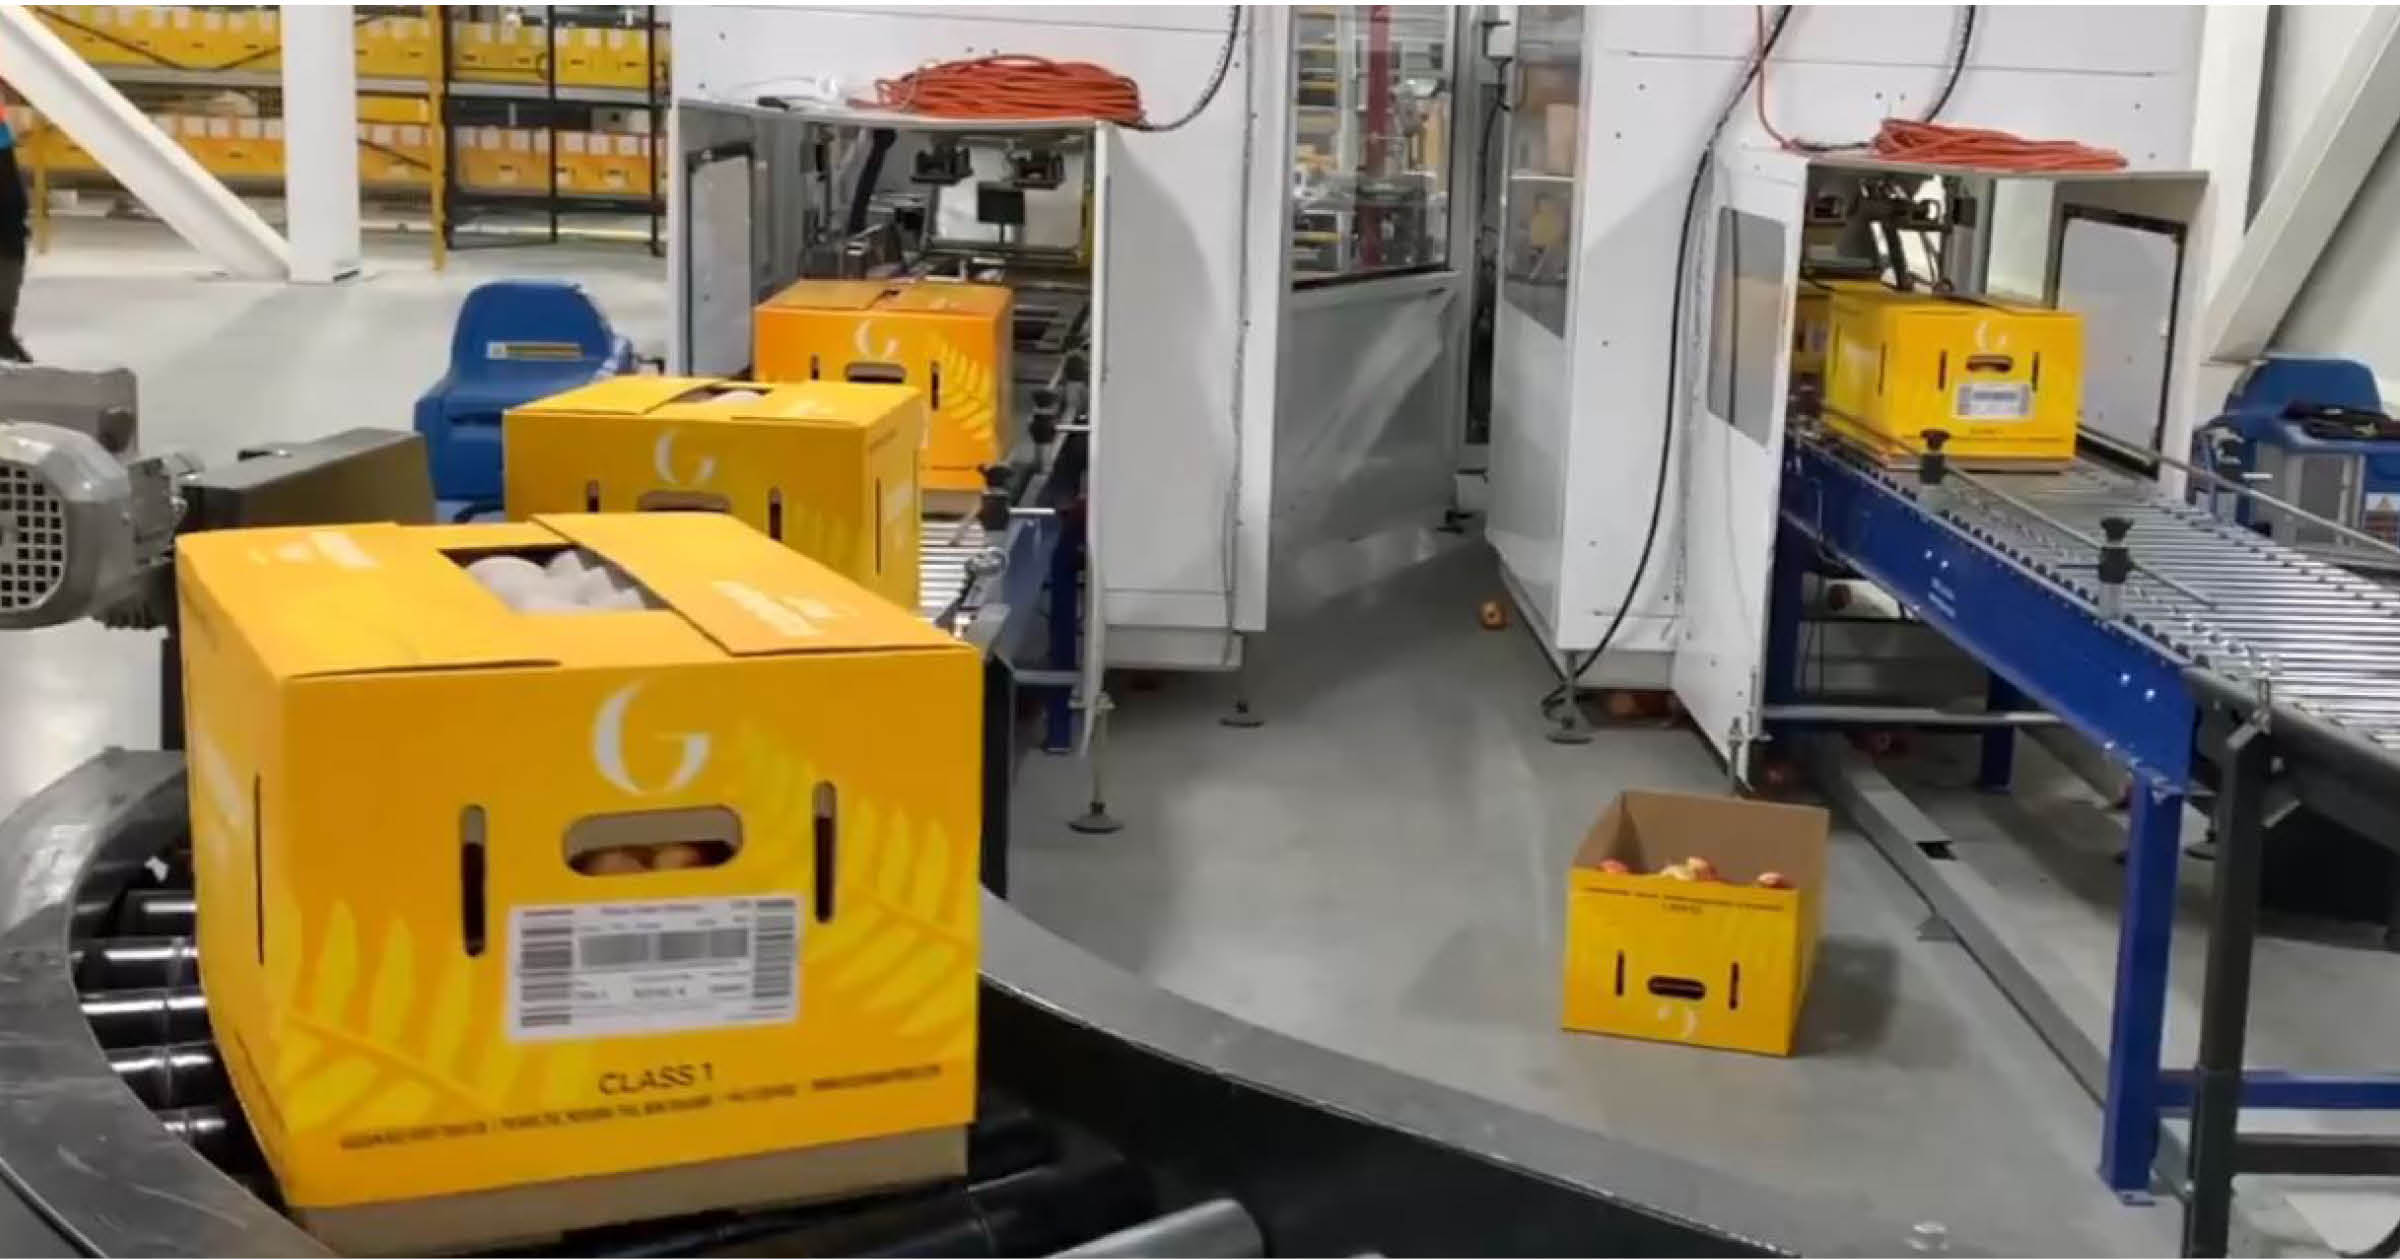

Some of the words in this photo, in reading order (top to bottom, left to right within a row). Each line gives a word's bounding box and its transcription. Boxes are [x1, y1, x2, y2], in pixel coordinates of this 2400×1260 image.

[653, 428, 718, 487] G
[593, 678, 711, 796] G
[598, 1065, 695, 1096] CLASS
[700, 1061, 713, 1082] 1
